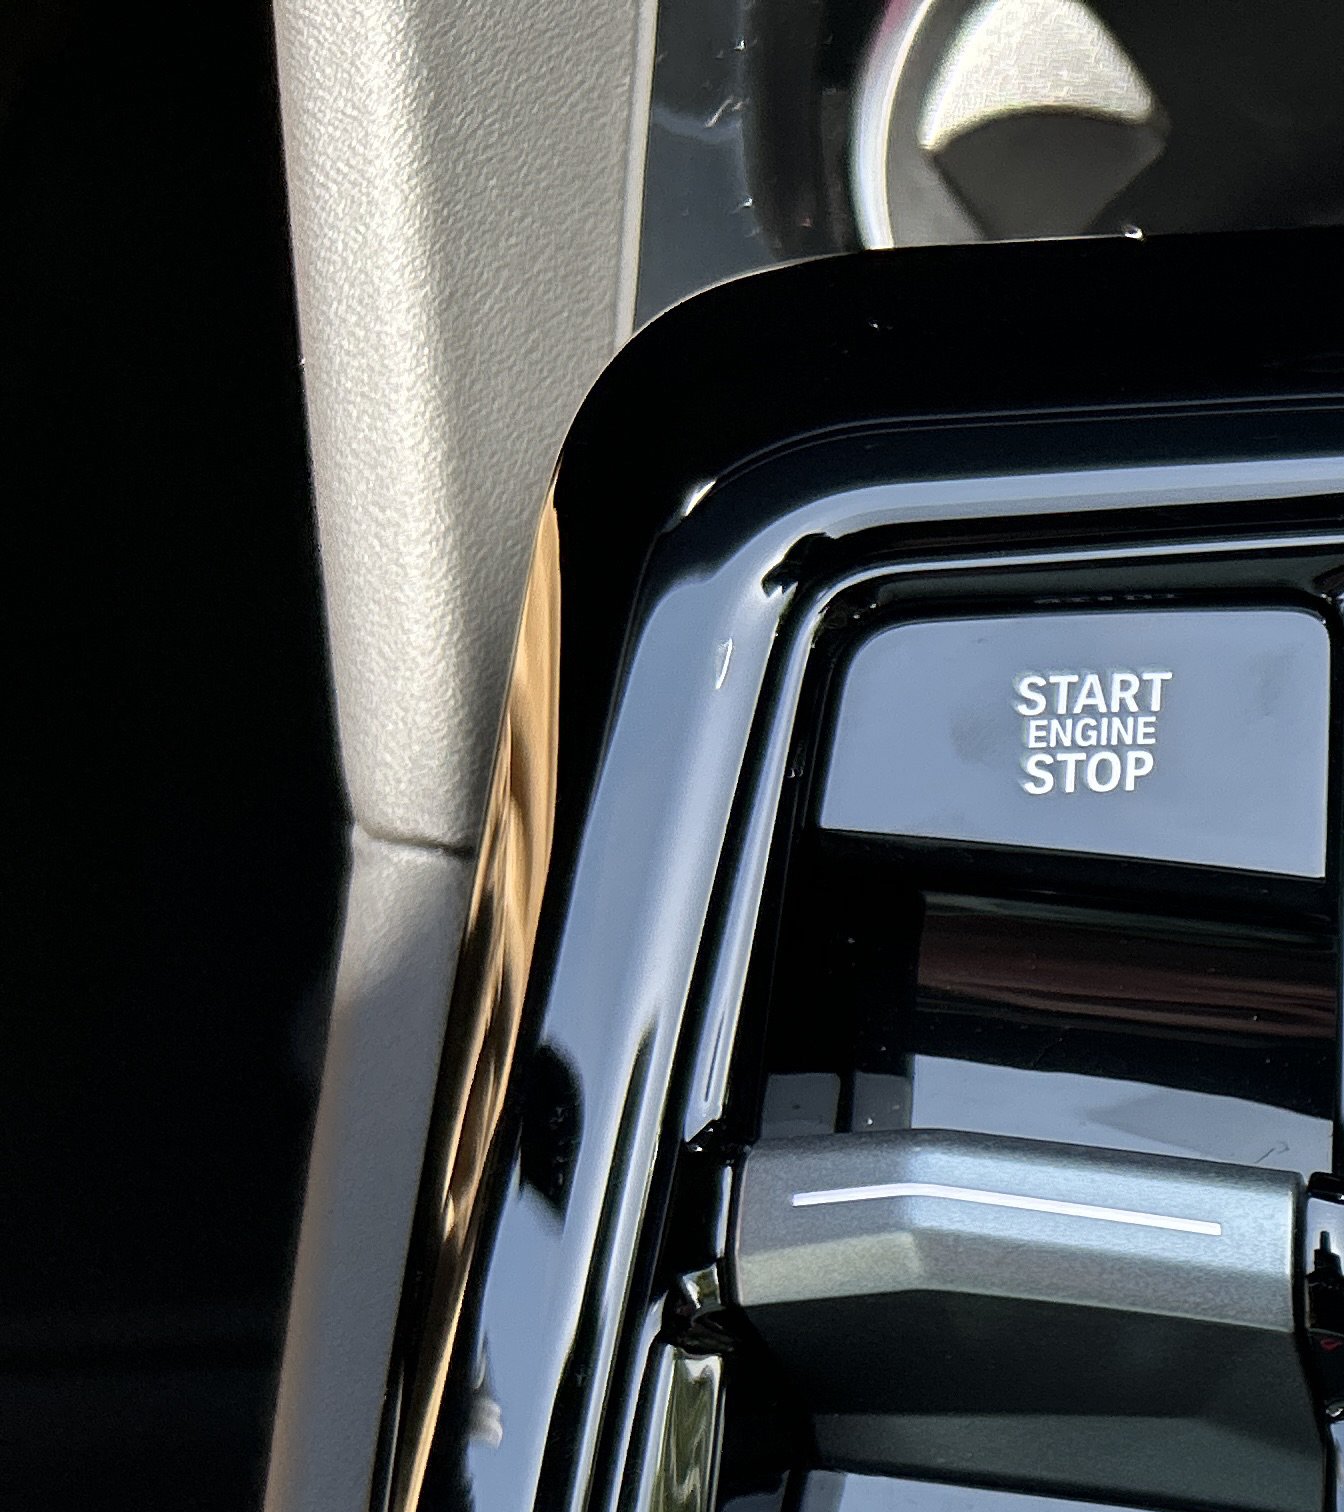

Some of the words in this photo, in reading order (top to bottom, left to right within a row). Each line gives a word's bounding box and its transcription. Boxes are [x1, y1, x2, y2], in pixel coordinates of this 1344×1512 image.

[1014, 671, 1173, 716] START
[1027, 717, 1157, 749] ENGINE
[1023, 750, 1154, 796] STOP
